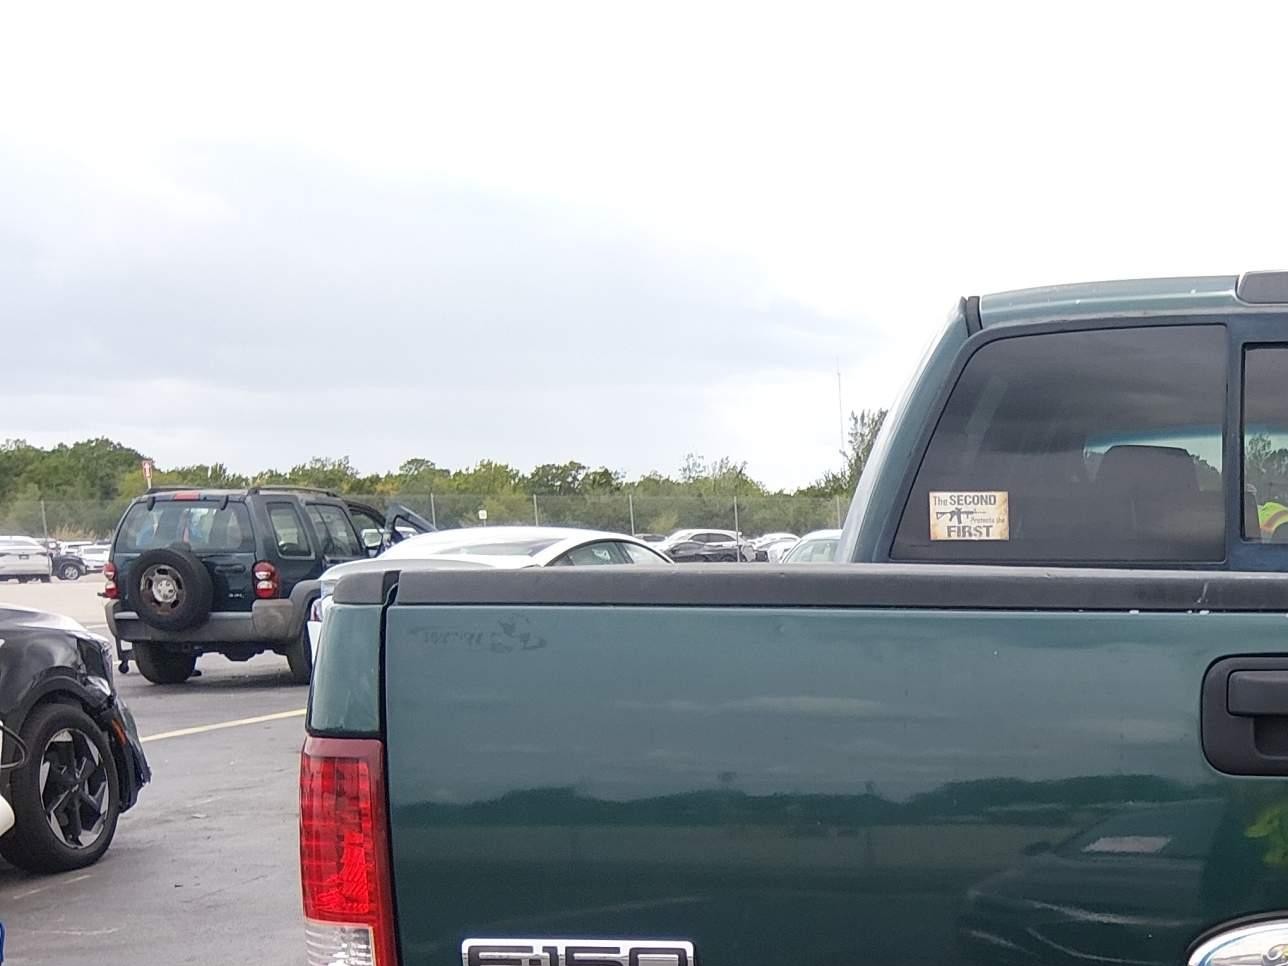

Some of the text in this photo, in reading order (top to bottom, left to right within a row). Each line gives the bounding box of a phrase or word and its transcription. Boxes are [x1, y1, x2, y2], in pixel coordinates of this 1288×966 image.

[933, 494, 996, 506] The SECOND
[946, 525, 993, 538] FIRST
